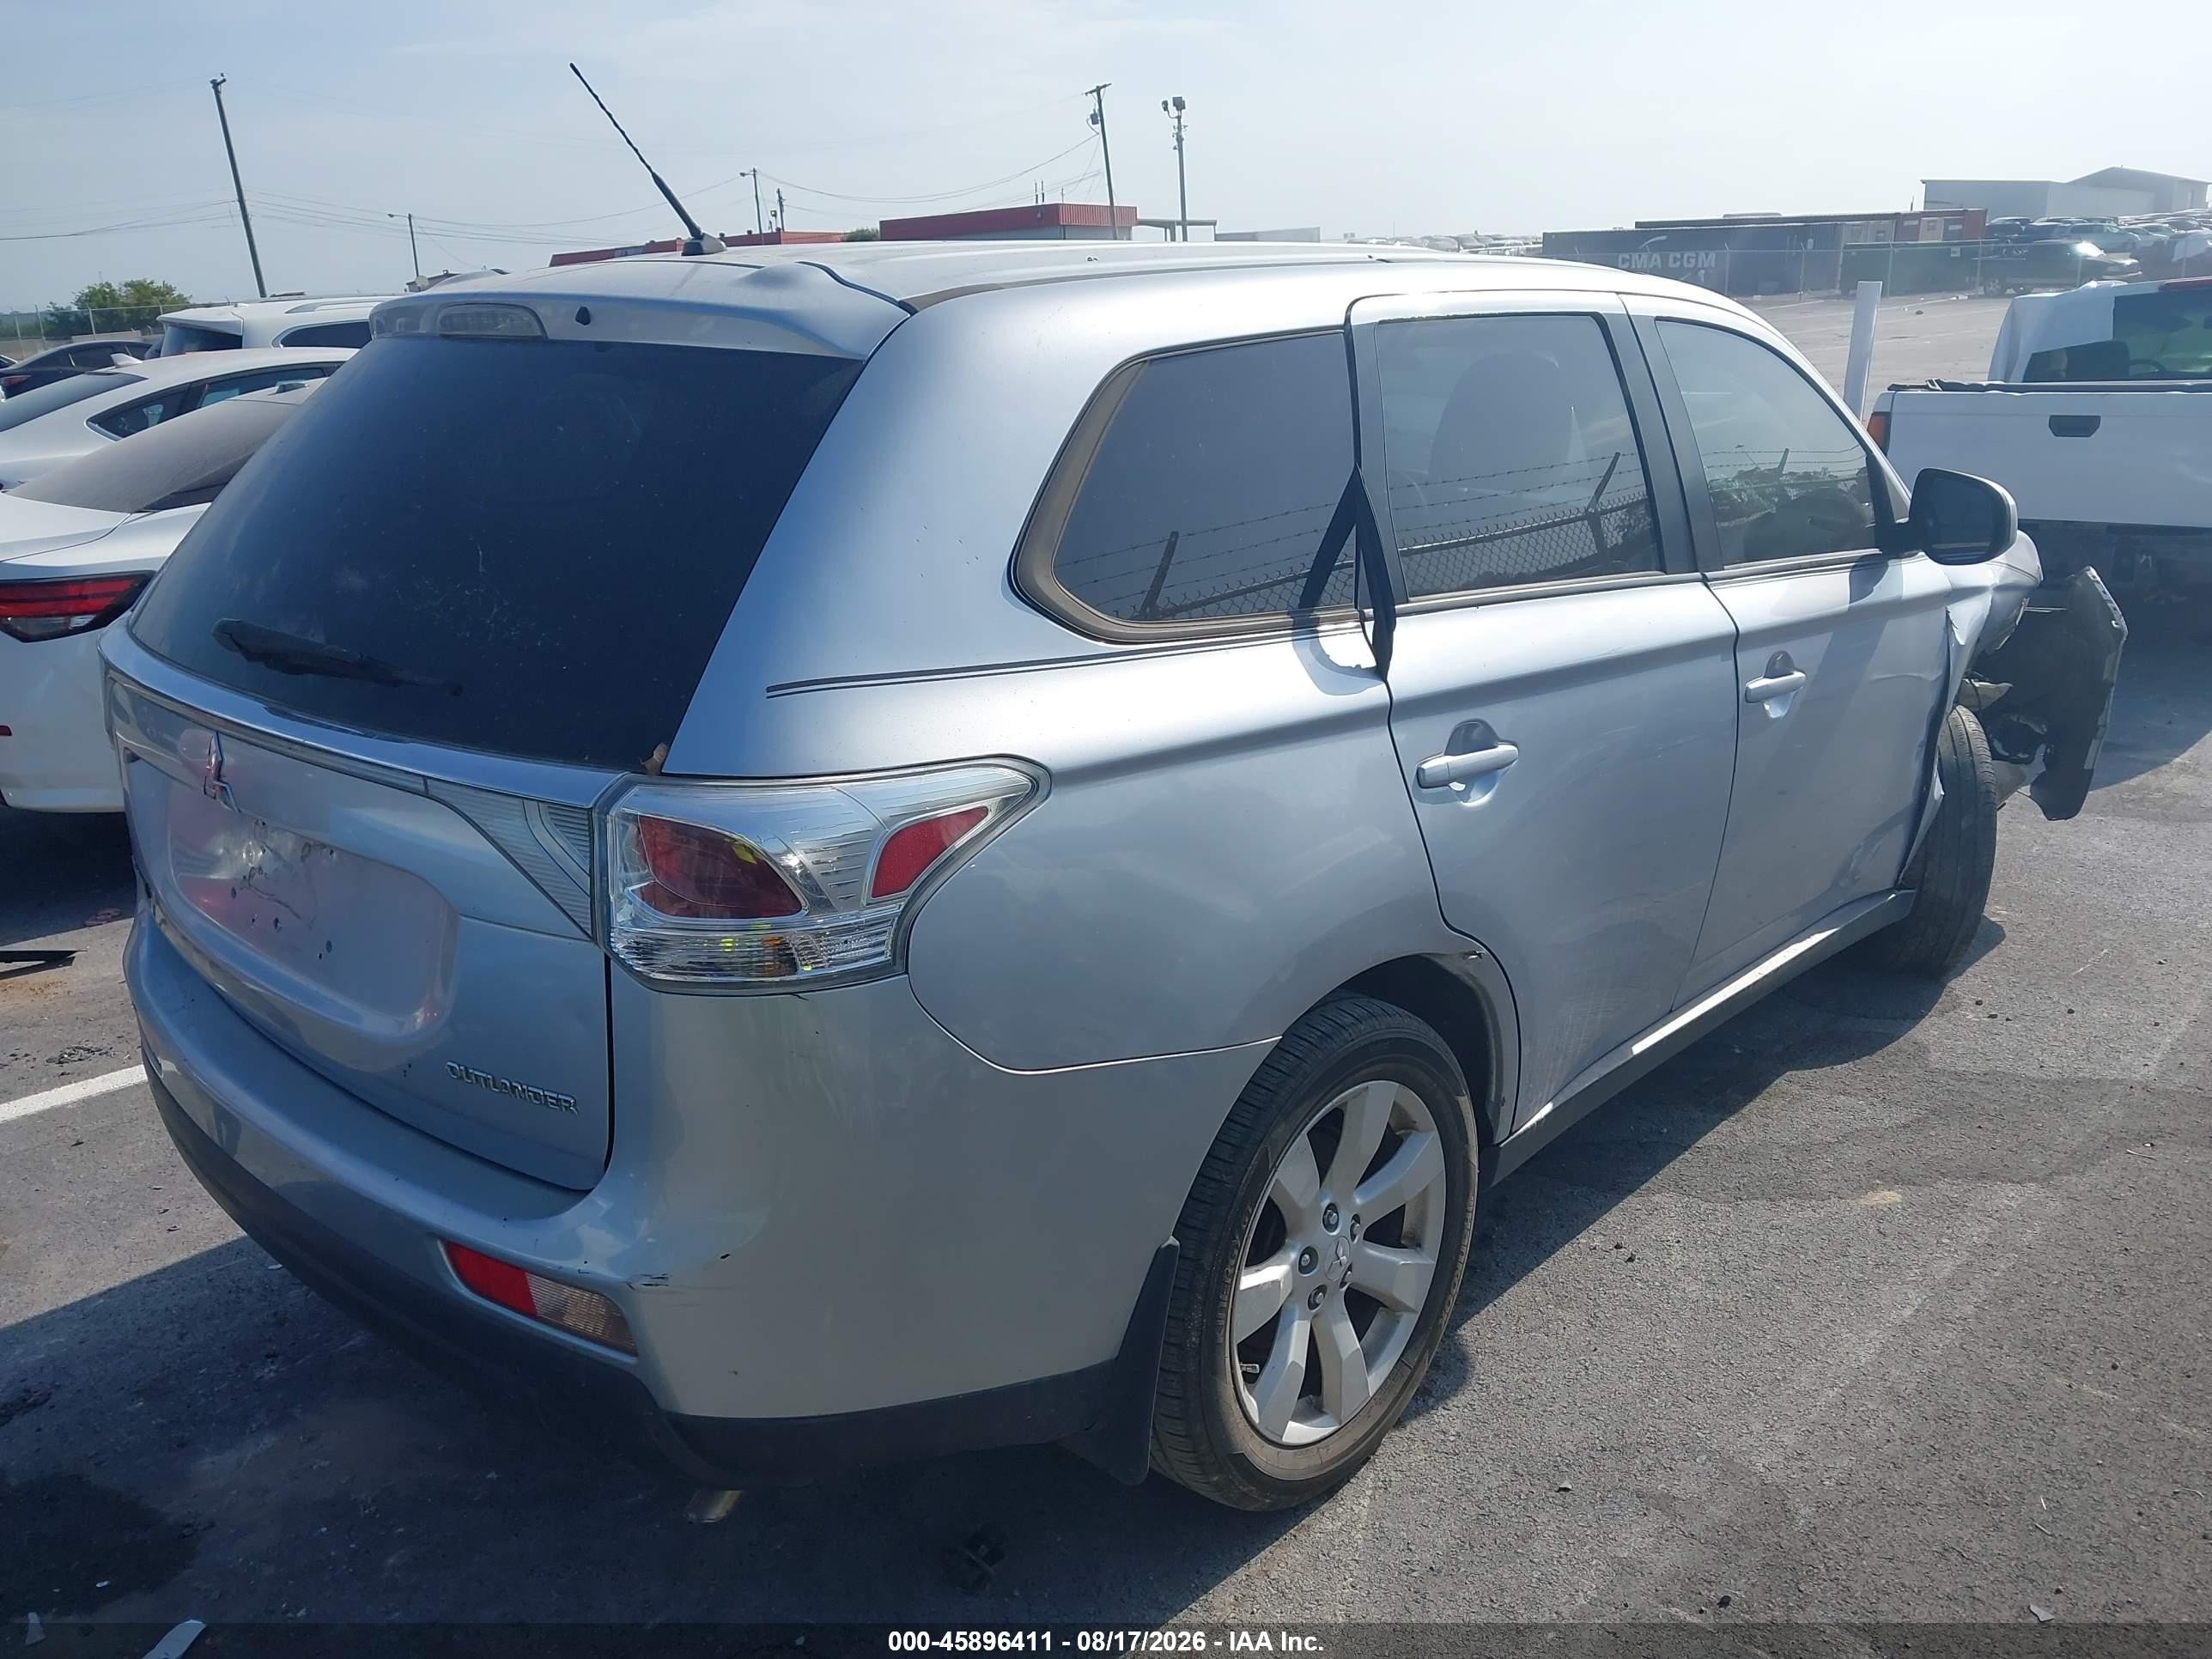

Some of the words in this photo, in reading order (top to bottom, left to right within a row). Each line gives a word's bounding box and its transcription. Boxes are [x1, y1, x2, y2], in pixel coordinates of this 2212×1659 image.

[1618, 252, 1662, 269] CMA
[1668, 252, 1717, 268] CGM
[445, 1060, 579, 1116] OUTLANDER
